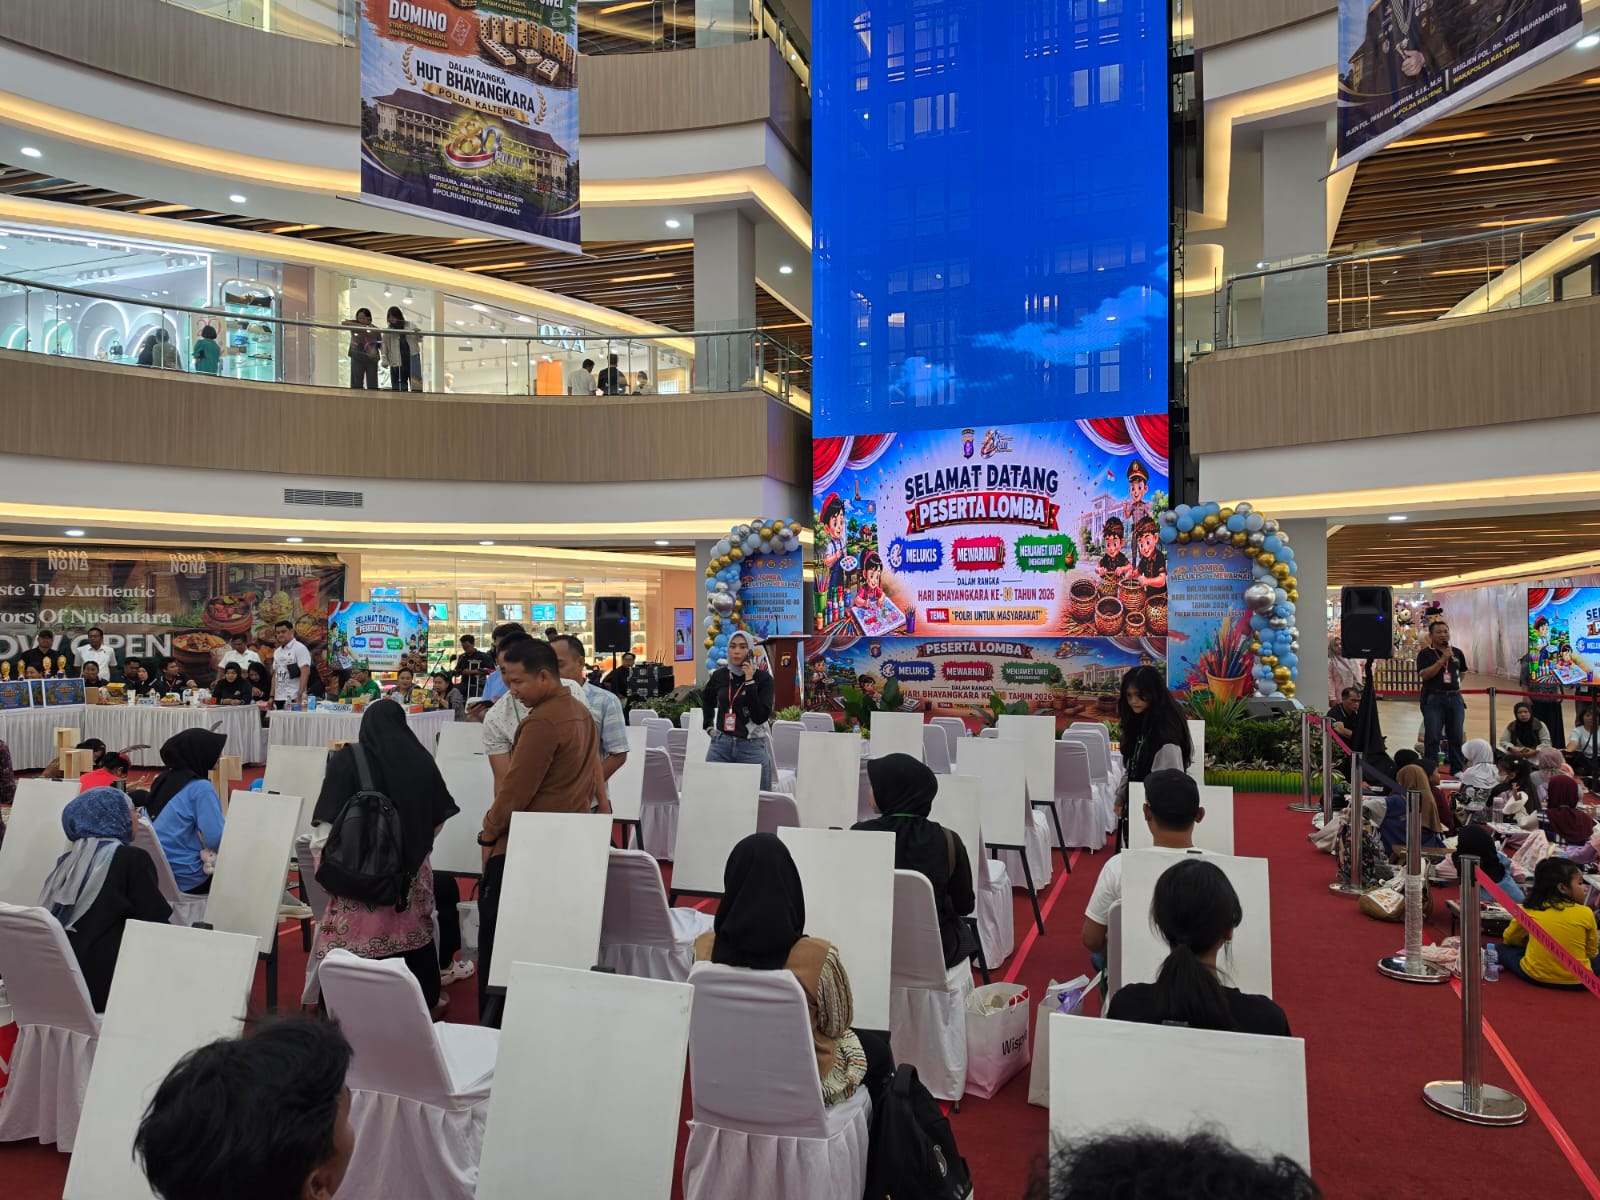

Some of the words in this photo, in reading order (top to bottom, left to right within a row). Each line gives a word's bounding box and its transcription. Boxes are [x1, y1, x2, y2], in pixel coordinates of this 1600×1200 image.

[388, 0, 448, 32] DOMINO
[448, 61, 475, 77] DALAM
[476, 70, 506, 86] RANGKA
[416, 60, 442, 84] HUT
[446, 73, 535, 114] BHAYANGKARA
[439, 88, 471, 105] POLDA
[475, 100, 516, 117] KALTENG
[905, 465, 982, 502] SELAMAT
[986, 464, 1058, 495] DATANG
[919, 496, 987, 525] PESERTA
[989, 495, 1046, 522] LOMBA
[905, 547, 937, 563] MELUKIS
[956, 547, 996, 562] MEWARNAI
[957, 577, 975, 586] DALAM
[977, 576, 999, 586] RANGKA
[29, 583, 66, 597] The
[71, 584, 156, 598] Authentic
[918, 589, 935, 601] HARI
[936, 588, 989, 601] BHAYANGKARA
[1014, 588, 1037, 600] TAHUN
[1038, 588, 1055, 600] 2026
[0, 612, 35, 624] ors
[39, 608, 68, 624] Of
[71, 609, 172, 624] Nusantara
[974, 610, 995, 621] UNTUK
[926, 643, 976, 655] PESERTA
[979, 643, 1022, 656] LOMBA
[898, 666, 930, 676] MELUKIS
[946, 667, 985, 677] MEWARNAI
[902, 690, 920, 698] HARI
[922, 690, 979, 699] BHAYANGKARA
[1009, 692, 1033, 700] TAHUN
[1035, 692, 1053, 701] 2026
[1520, 912, 1565, 961] DIREKTORAT
